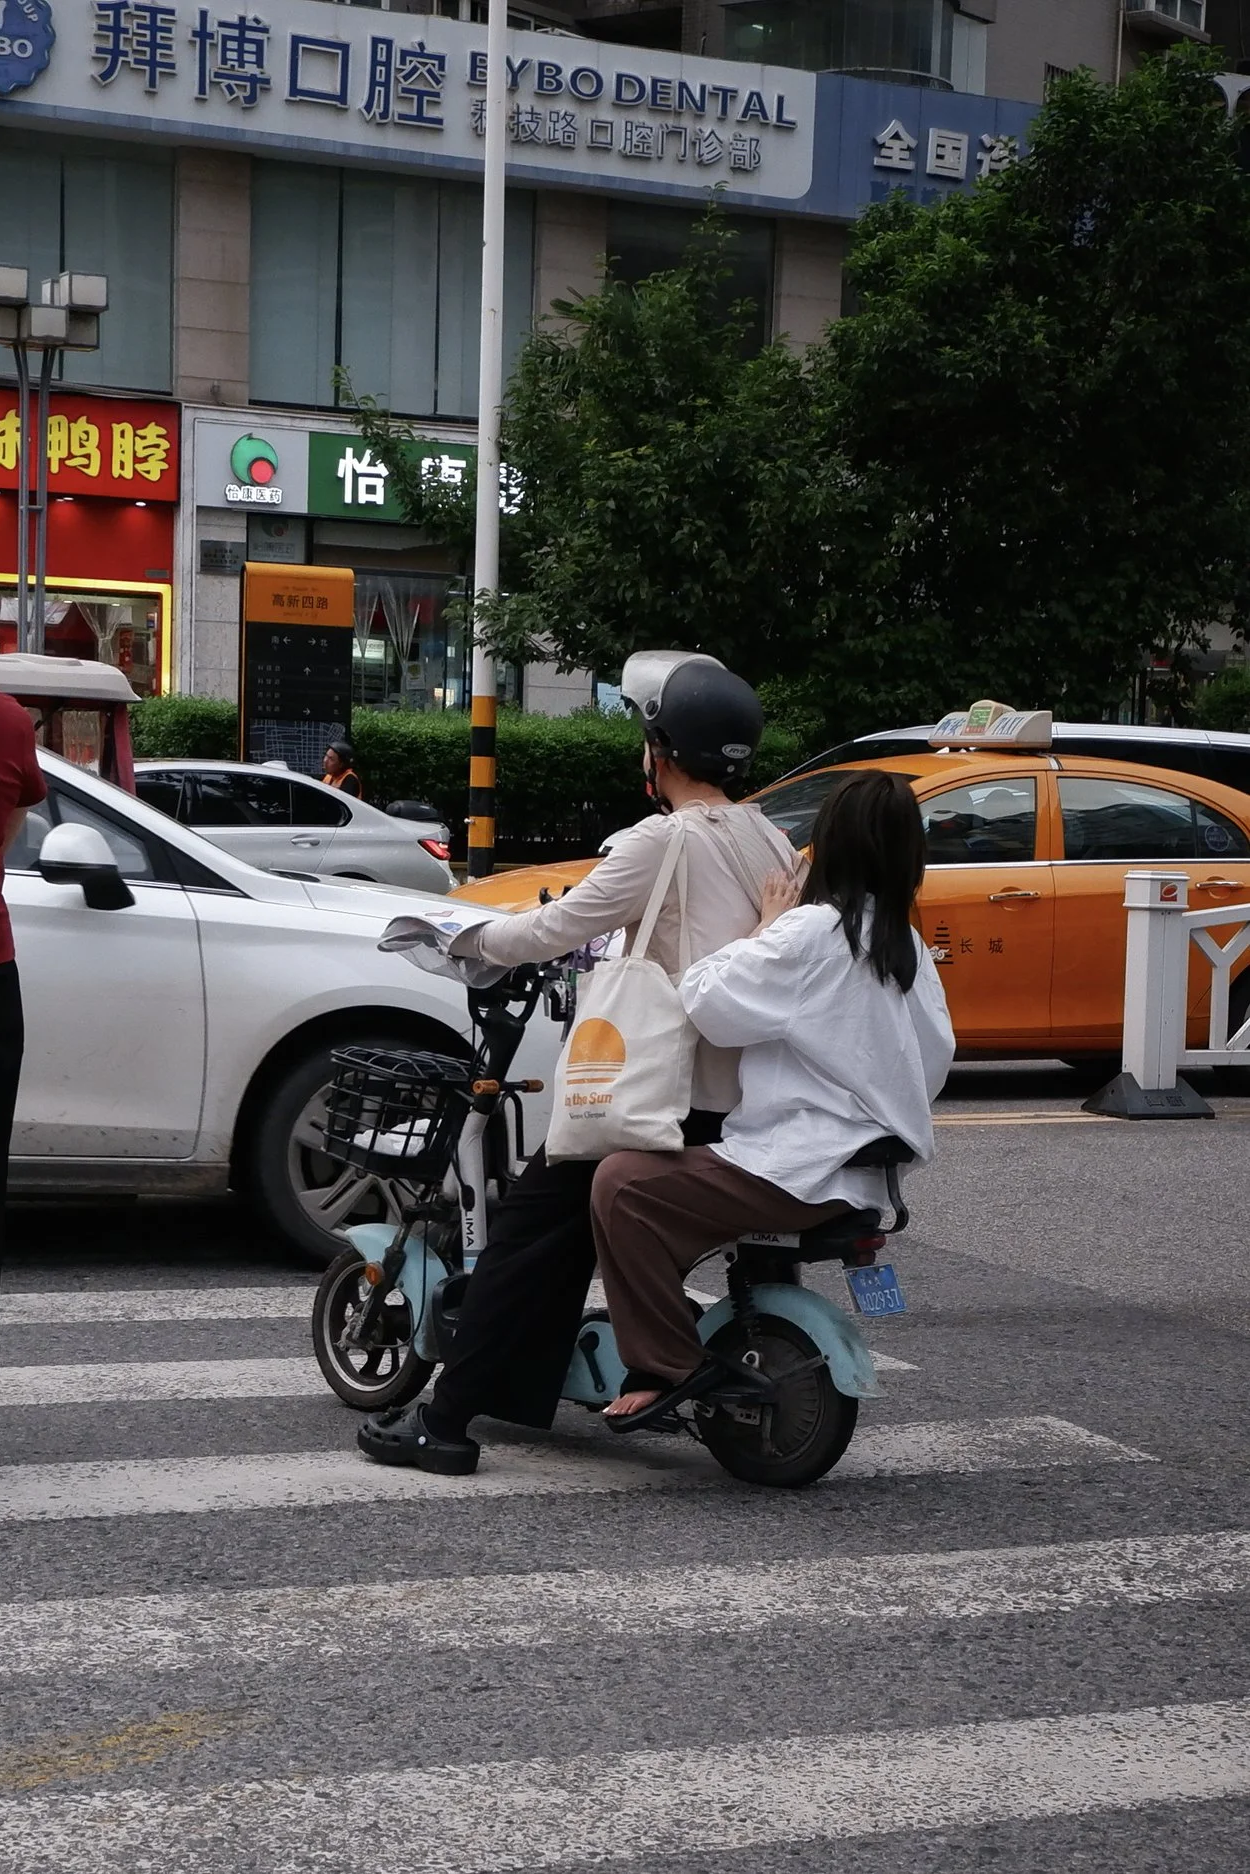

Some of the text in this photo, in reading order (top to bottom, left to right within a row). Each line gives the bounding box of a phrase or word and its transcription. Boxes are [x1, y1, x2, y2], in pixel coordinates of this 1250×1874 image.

[91, 0, 448, 130] 拜博口腔
[467, 50, 798, 130] BYBO DENTAL
[226, 484, 282, 503] 怡康医药
[272, 593, 328, 609] 高新四路
[991, 717, 1025, 735] TAXI
[960, 937, 1004, 954] 长城
[573, 1092, 588, 1106] the
[589, 1092, 613, 1105] Sun
[464, 1208, 475, 1248] LIMA
[752, 1233, 780, 1243] LIMA
